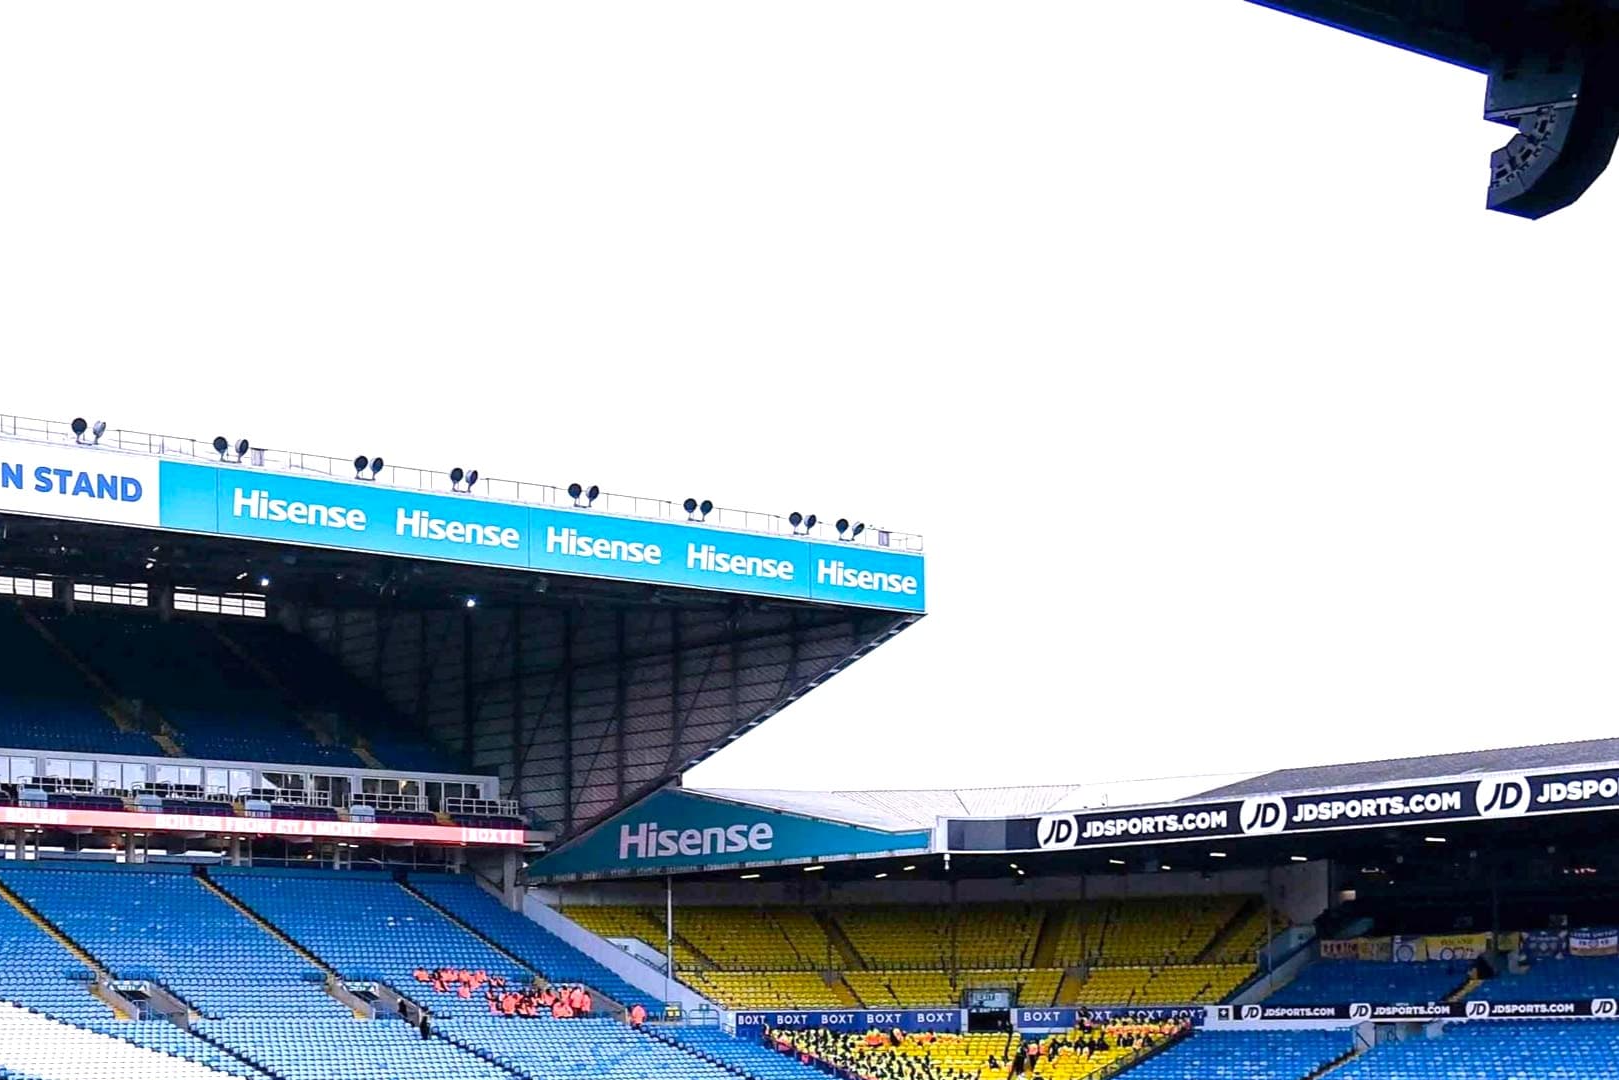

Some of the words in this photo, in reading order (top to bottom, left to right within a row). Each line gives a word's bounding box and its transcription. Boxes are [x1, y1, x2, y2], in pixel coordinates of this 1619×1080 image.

[34, 466, 143, 503] STAND
[232, 488, 367, 532] Hisense
[395, 508, 520, 550] Hisense
[546, 526, 661, 565] Hisense
[687, 543, 794, 580] Hisense
[818, 559, 917, 595] Hisense
[1291, 790, 1461, 822] JDSPORTS.COM
[1484, 782, 1522, 812] JD
[1082, 810, 1227, 838] JDSPORTS.COM
[619, 821, 773, 861] Hisense
[738, 1015, 766, 1025] BOXT
[777, 1014, 808, 1024] BOXT
[821, 1014, 855, 1024] BOXT
[867, 1013, 902, 1024] BOXT
[917, 1012, 954, 1023] BOXT
[1023, 1012, 1060, 1022] BOXT
[1263, 1007, 1335, 1017] JDSPORTS.COM
[1373, 1005, 1450, 1016] JDSPORTS.COM
[1491, 1003, 1574, 1014] JDSPORTS.COM
